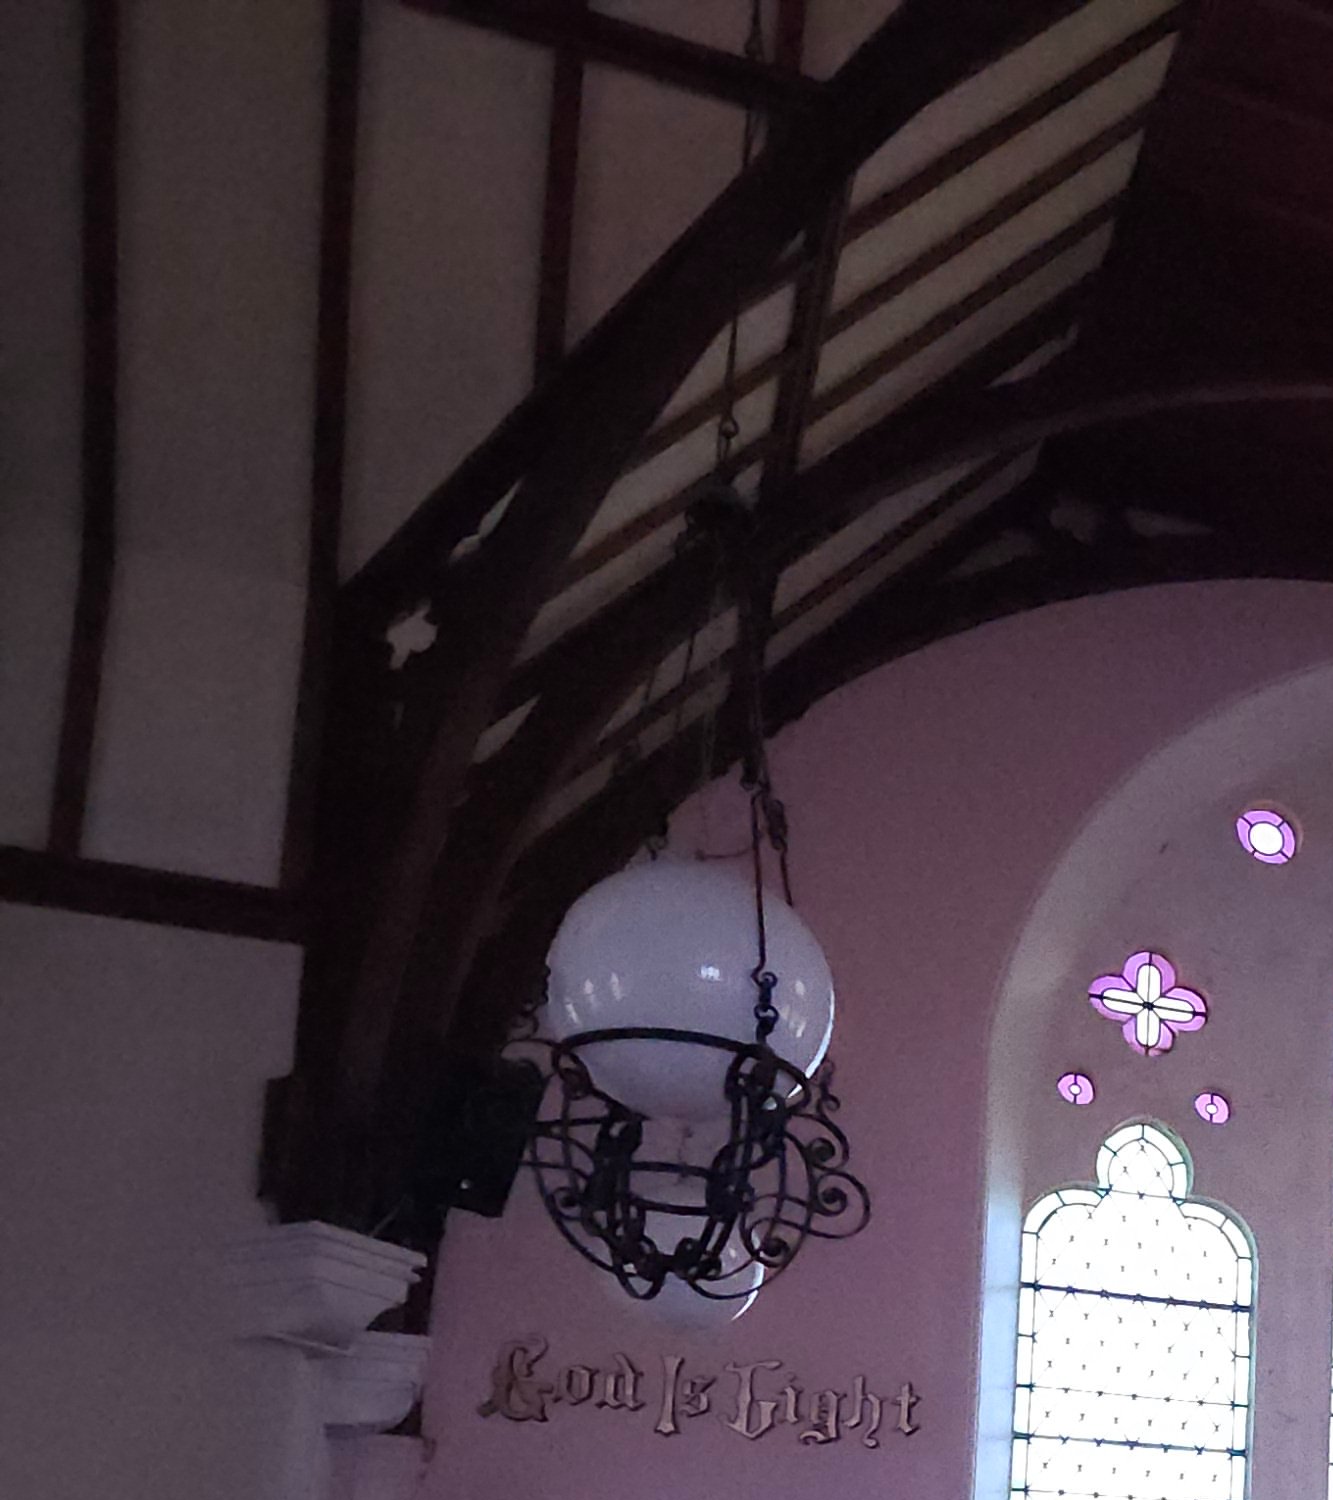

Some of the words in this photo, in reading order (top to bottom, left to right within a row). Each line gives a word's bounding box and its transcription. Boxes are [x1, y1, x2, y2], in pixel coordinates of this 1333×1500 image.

[477, 1336, 646, 1422] God
[654, 1354, 717, 1435] Is
[718, 1359, 920, 1448] Light
